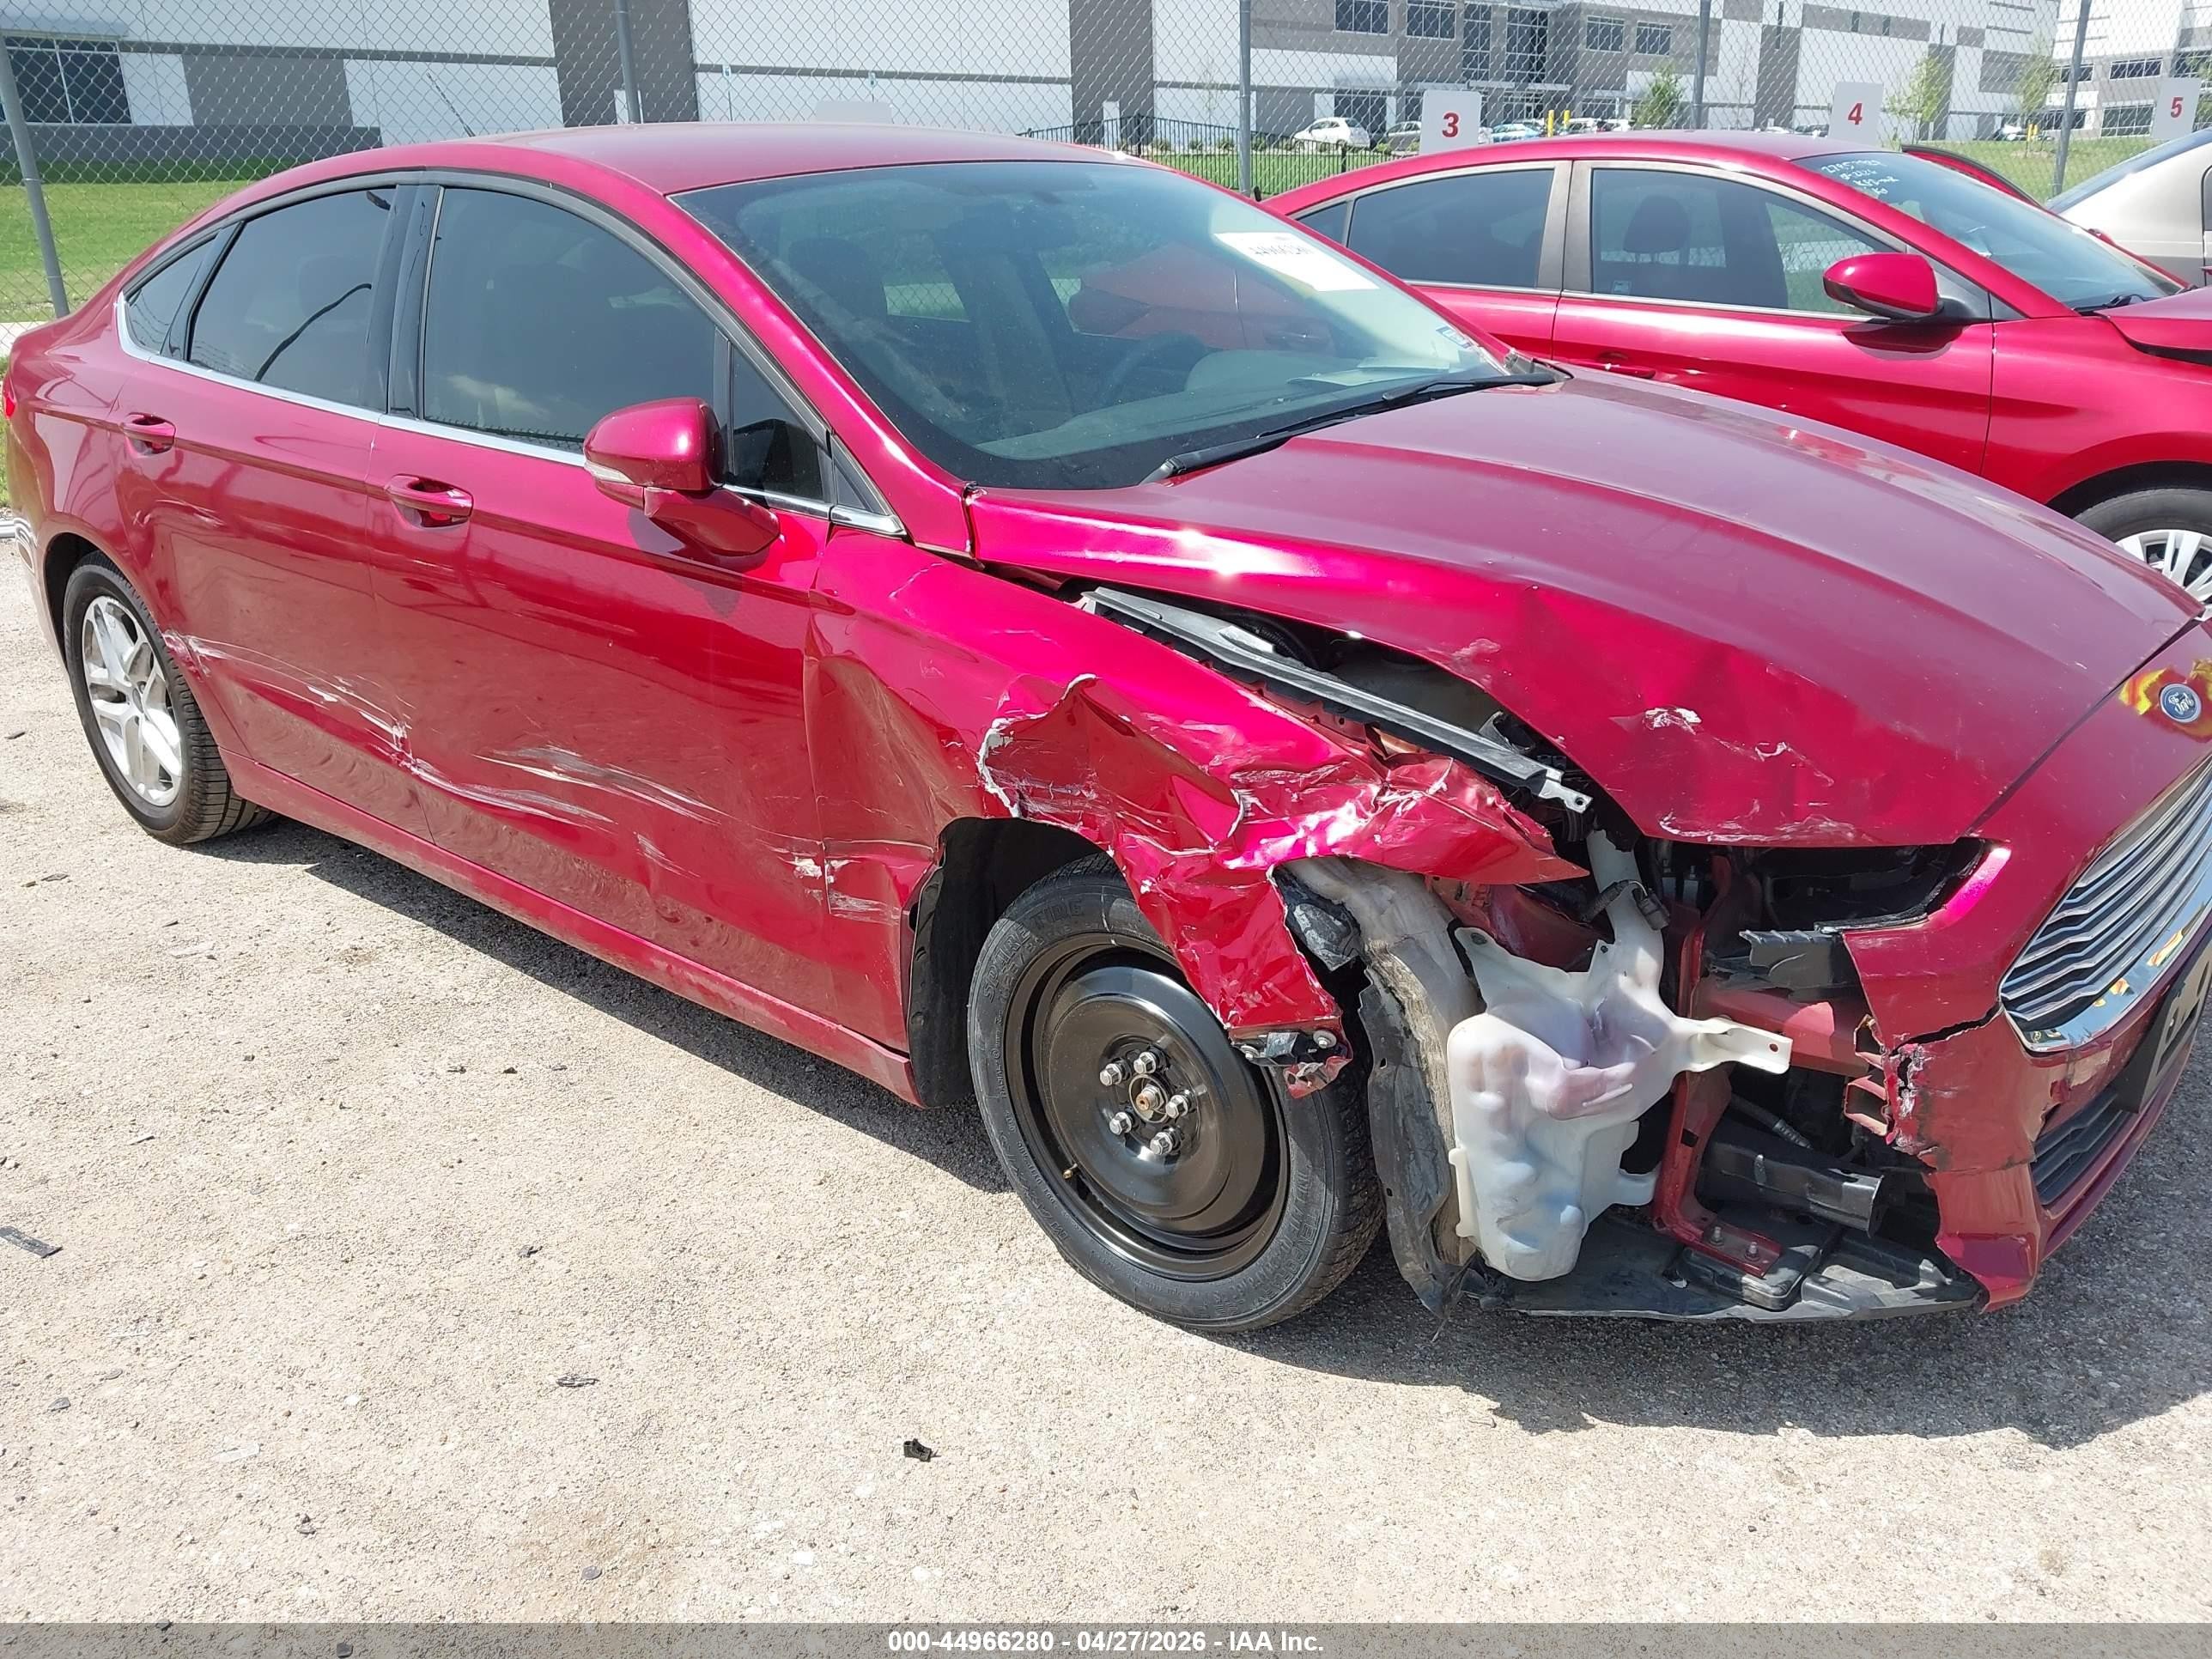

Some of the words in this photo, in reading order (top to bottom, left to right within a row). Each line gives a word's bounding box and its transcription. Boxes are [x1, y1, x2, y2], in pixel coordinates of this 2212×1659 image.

[1847, 103, 1863, 125] 4
[2170, 96, 2184, 118] 5
[1443, 112, 1460, 137] 3
